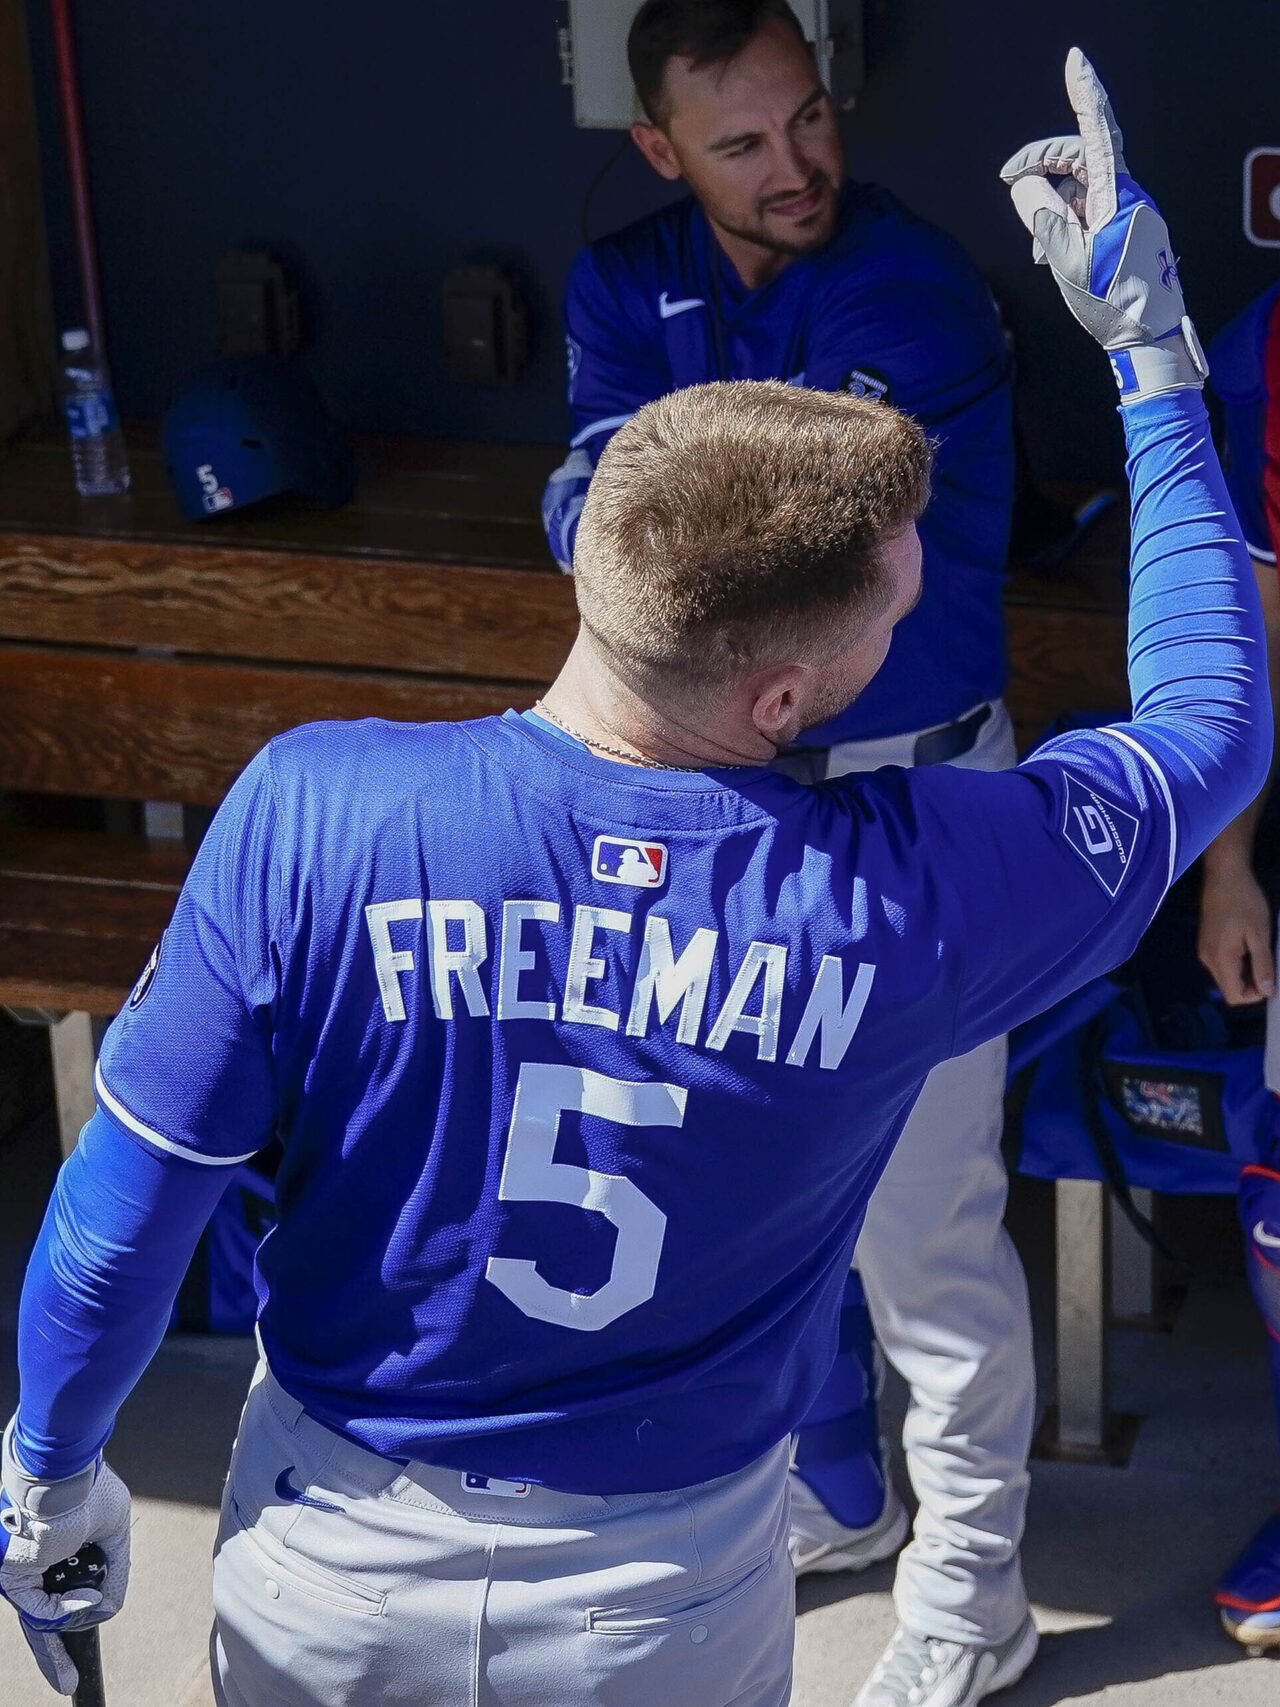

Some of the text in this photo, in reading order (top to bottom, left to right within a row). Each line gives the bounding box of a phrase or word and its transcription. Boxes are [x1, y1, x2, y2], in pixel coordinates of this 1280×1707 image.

[197, 464, 218, 494] 5
[364, 898, 876, 1070] FREEMAN
[484, 1061, 689, 1332] 5
